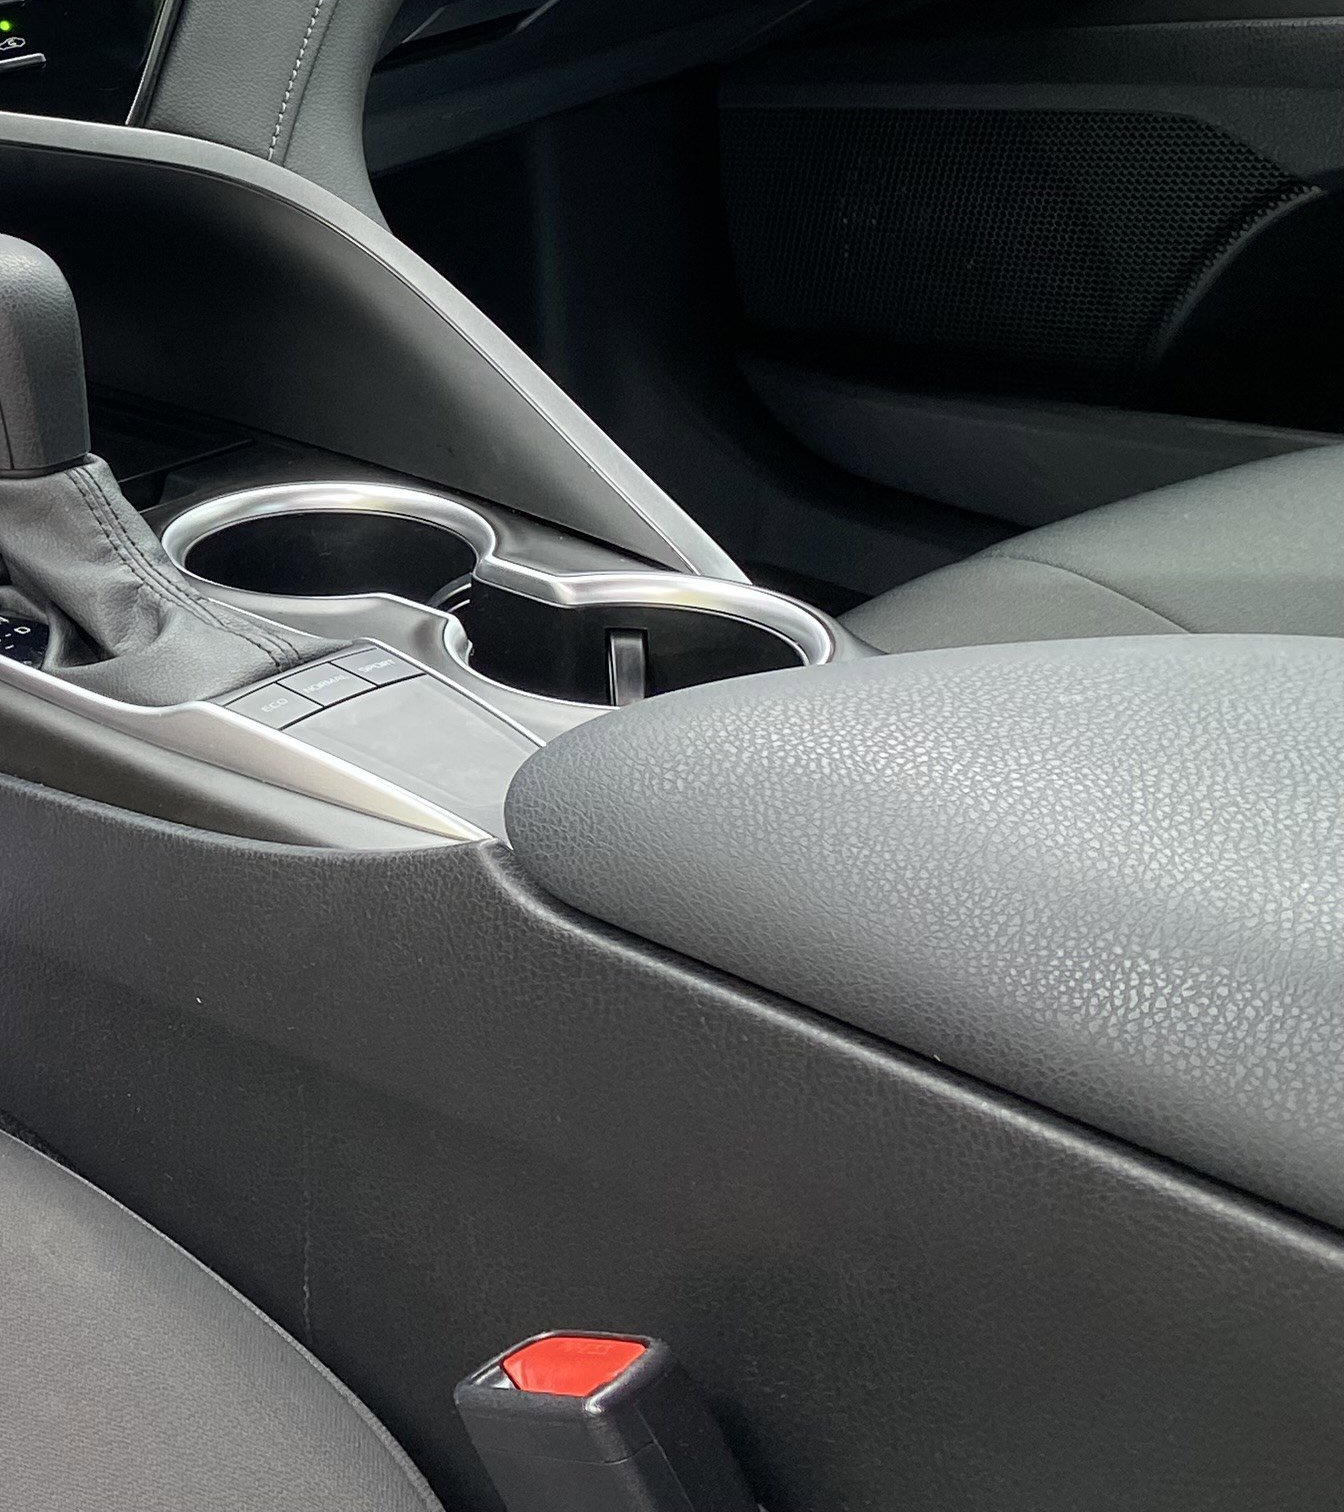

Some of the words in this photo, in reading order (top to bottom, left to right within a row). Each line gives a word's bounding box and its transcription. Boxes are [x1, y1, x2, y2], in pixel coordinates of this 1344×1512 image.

[357, 659, 396, 674] SPORT
[303, 674, 352, 694] NORMAL
[261, 697, 289, 713] ECO
